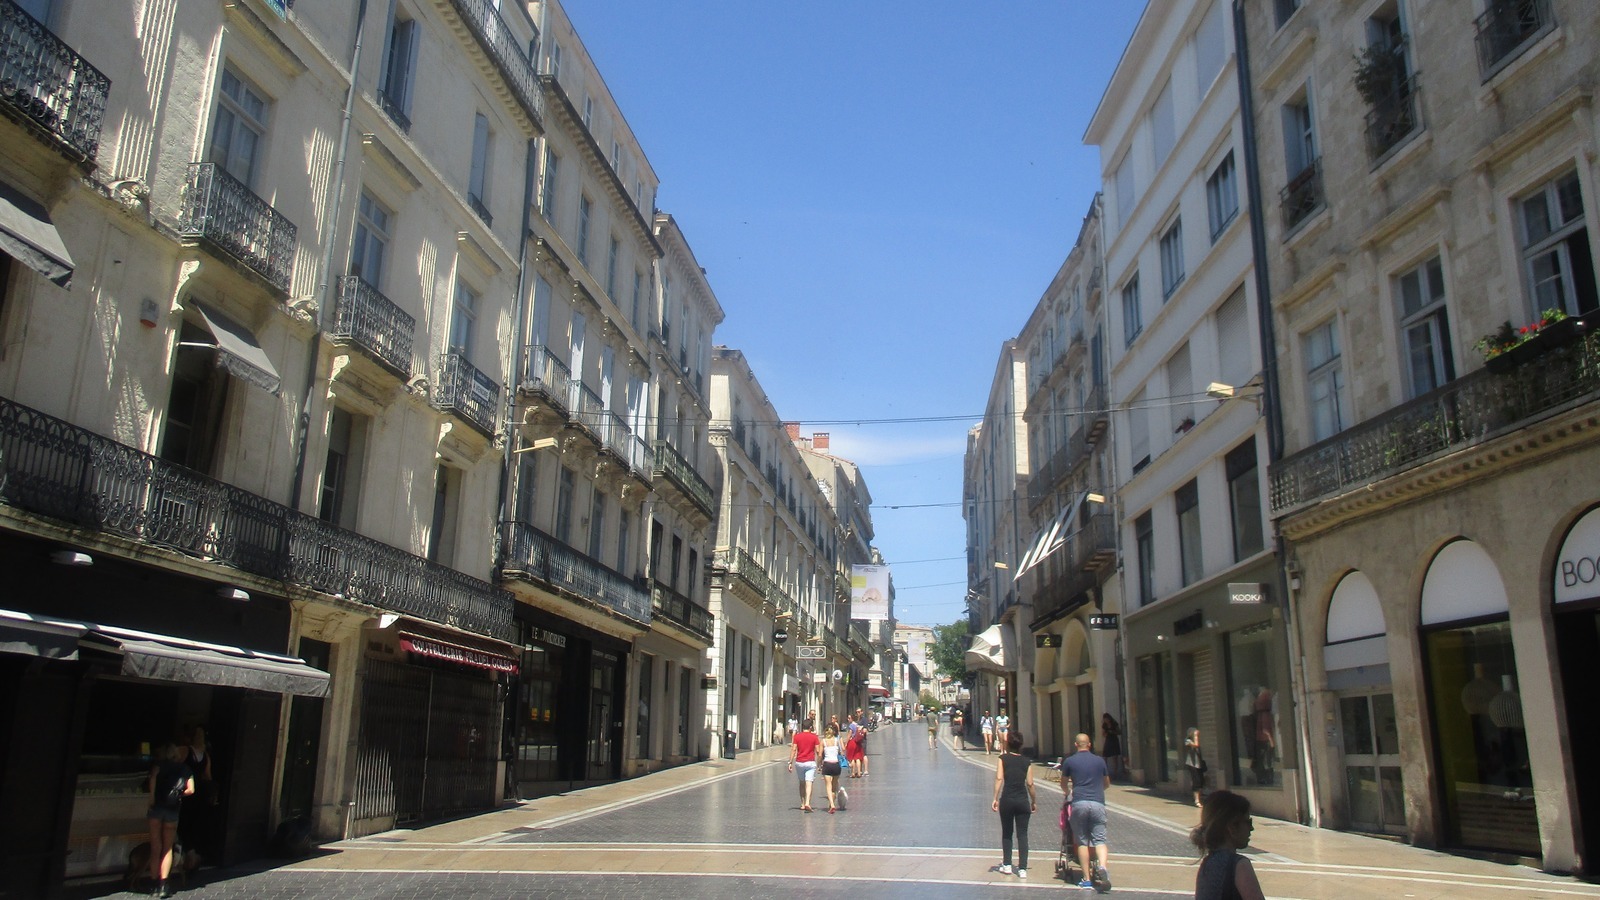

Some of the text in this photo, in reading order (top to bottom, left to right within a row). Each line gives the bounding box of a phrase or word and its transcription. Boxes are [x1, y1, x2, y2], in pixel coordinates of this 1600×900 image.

[1562, 556, 1600, 587] BO
[412, 639, 464, 661] COUTELLERIE
[465, 651, 491, 667] PRADEL
